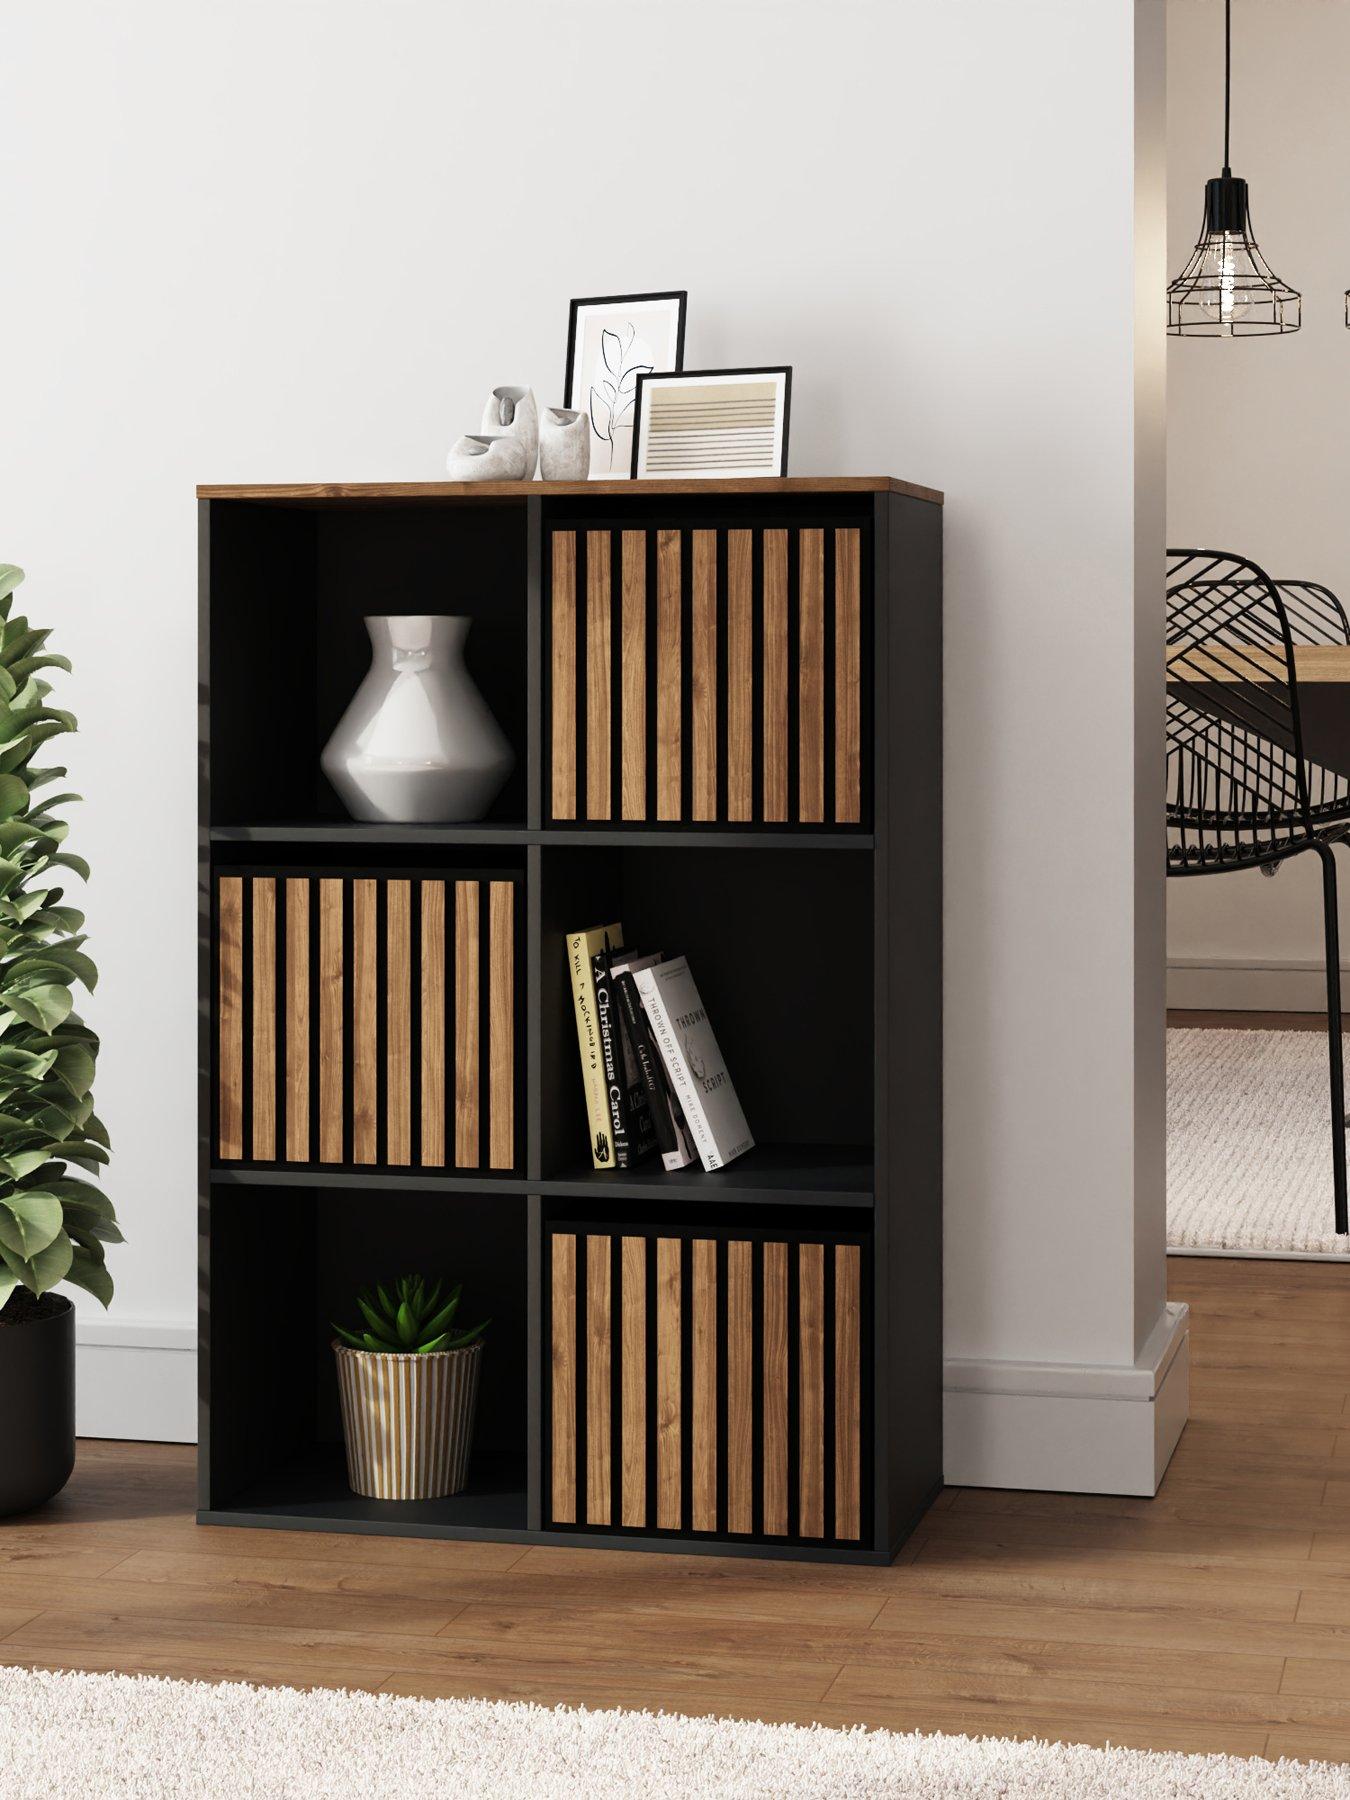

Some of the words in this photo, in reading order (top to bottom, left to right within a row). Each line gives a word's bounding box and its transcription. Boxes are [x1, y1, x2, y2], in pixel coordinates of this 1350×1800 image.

[573, 936, 581, 949] TO
[573, 954, 582, 976] KILL
[594, 968, 606, 983] A
[675, 1007, 708, 1029] THROWN
[578, 995, 597, 1069] MOCKINGBIRD
[598, 987, 615, 1081] Christmas
[647, 998, 668, 1036] THROWN
[663, 1037, 675, 1054] OFF
[670, 1056, 687, 1088] SCRIPT
[702, 1072, 726, 1094] SCRIPT
[609, 1085, 625, 1135] Carol
